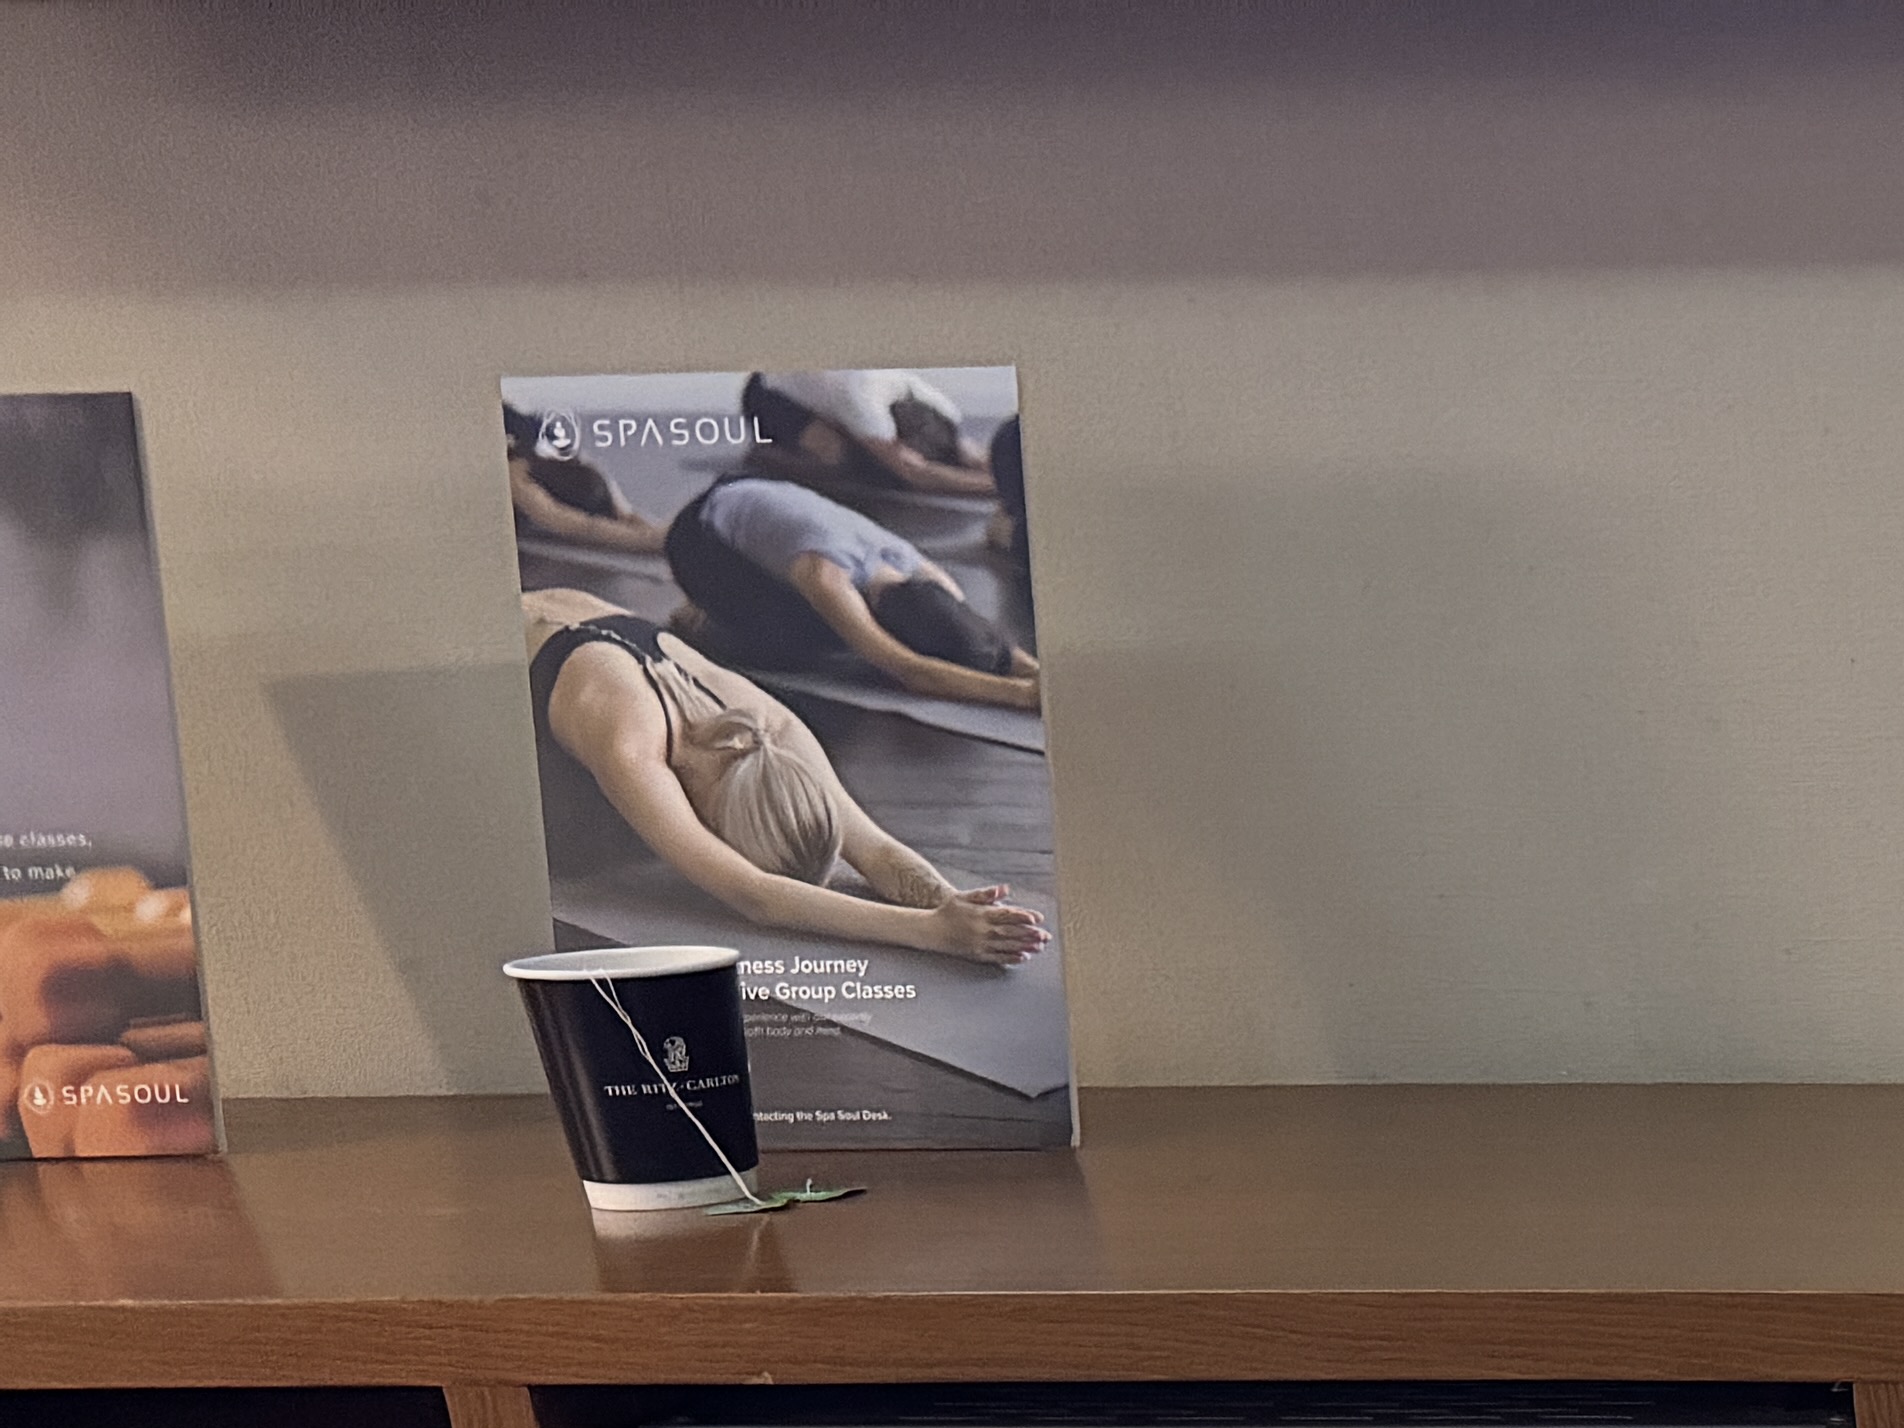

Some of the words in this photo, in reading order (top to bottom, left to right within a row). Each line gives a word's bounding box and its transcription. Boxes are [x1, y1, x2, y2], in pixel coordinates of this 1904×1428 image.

[19, 831, 92, 852] classes,
[2, 865, 22, 881] to
[28, 863, 76, 881] make
[737, 959, 785, 974] ness
[790, 956, 869, 977] Journey
[741, 982, 770, 1000] ive
[774, 982, 836, 1003] Group
[841, 980, 917, 1000] Classes
[744, 1013, 788, 1024] perience
[766, 1026, 792, 1038] body
[793, 1025, 814, 1036] and
[604, 1084, 638, 1097] THE
[753, 1111, 795, 1123] ntacting
[796, 1110, 813, 1121] the
[815, 1110, 836, 1122] Spa
[837, 1109, 860, 1121] Soul
